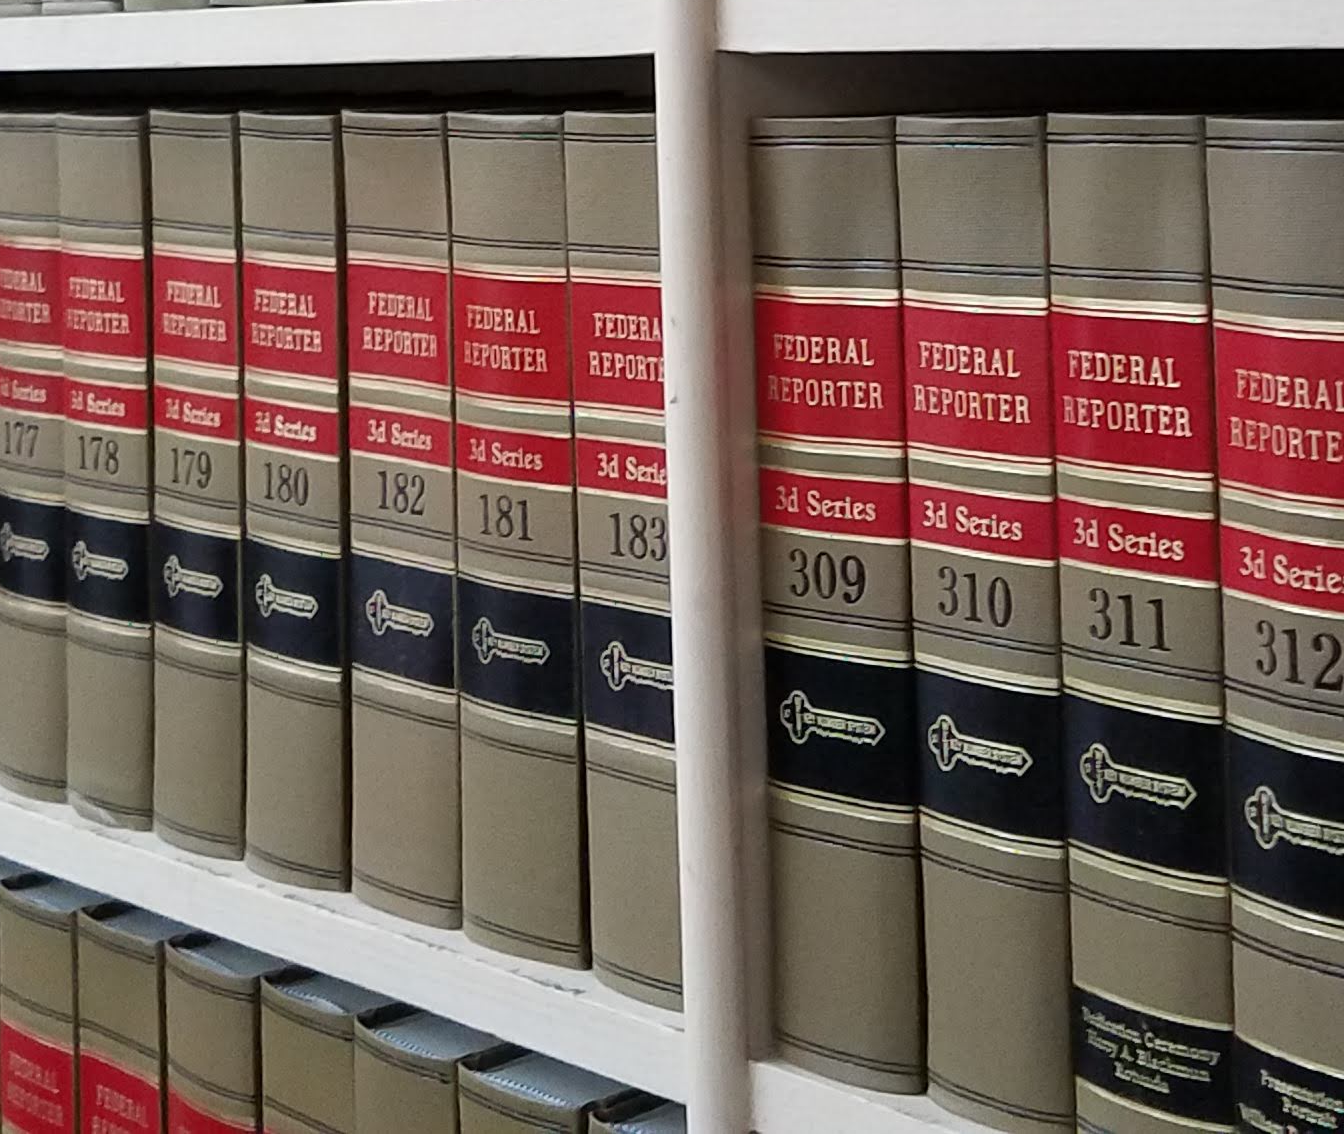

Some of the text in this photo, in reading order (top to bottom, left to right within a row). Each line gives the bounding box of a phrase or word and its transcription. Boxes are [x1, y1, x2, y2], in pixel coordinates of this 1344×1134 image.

[69, 277, 125, 303] FEDERAL
[166, 281, 222, 308] FEDERAL
[254, 289, 317, 318] FEDERAL
[367, 290, 433, 322] FEDERAL
[466, 304, 541, 334] FEDERAL
[592, 312, 661, 341] FEDERA
[252, 322, 322, 353] REPORTER
[362, 326, 437, 358] REPORTER
[773, 333, 875, 367] FEDERAL
[464, 341, 548, 373] REPORTER
[588, 350, 665, 382] REPORTE
[918, 340, 1021, 378] FEDERAL
[1067, 350, 1181, 389] FEDERAL
[87, 394, 126, 416] Series
[767, 374, 885, 410] REPORTER
[913, 384, 1031, 425] REPORTER
[183, 402, 221, 427] Series
[274, 415, 317, 442] Series
[1062, 396, 1193, 438] REPORTER
[4, 421, 39, 458] 177
[367, 419, 432, 451] 3d Series
[78, 435, 119, 475] 178
[171, 447, 212, 489] 179
[469, 438, 543, 471] 3d Series
[597, 453, 667, 485] 3d Serie
[264, 462, 309, 506] 180
[377, 470, 425, 516] 182
[479, 494, 533, 541] 181
[775, 486, 876, 522] 3d Series
[922, 500, 1023, 543] 3d Series
[609, 512, 667, 562] 183
[1072, 518, 1185, 561] 3d Series
[788, 548, 867, 604] 309
[1238, 547, 1267, 580] 3d
[938, 565, 1014, 628] 310
[1088, 587, 1171, 652] 311
[1255, 619, 1344, 693] 312
